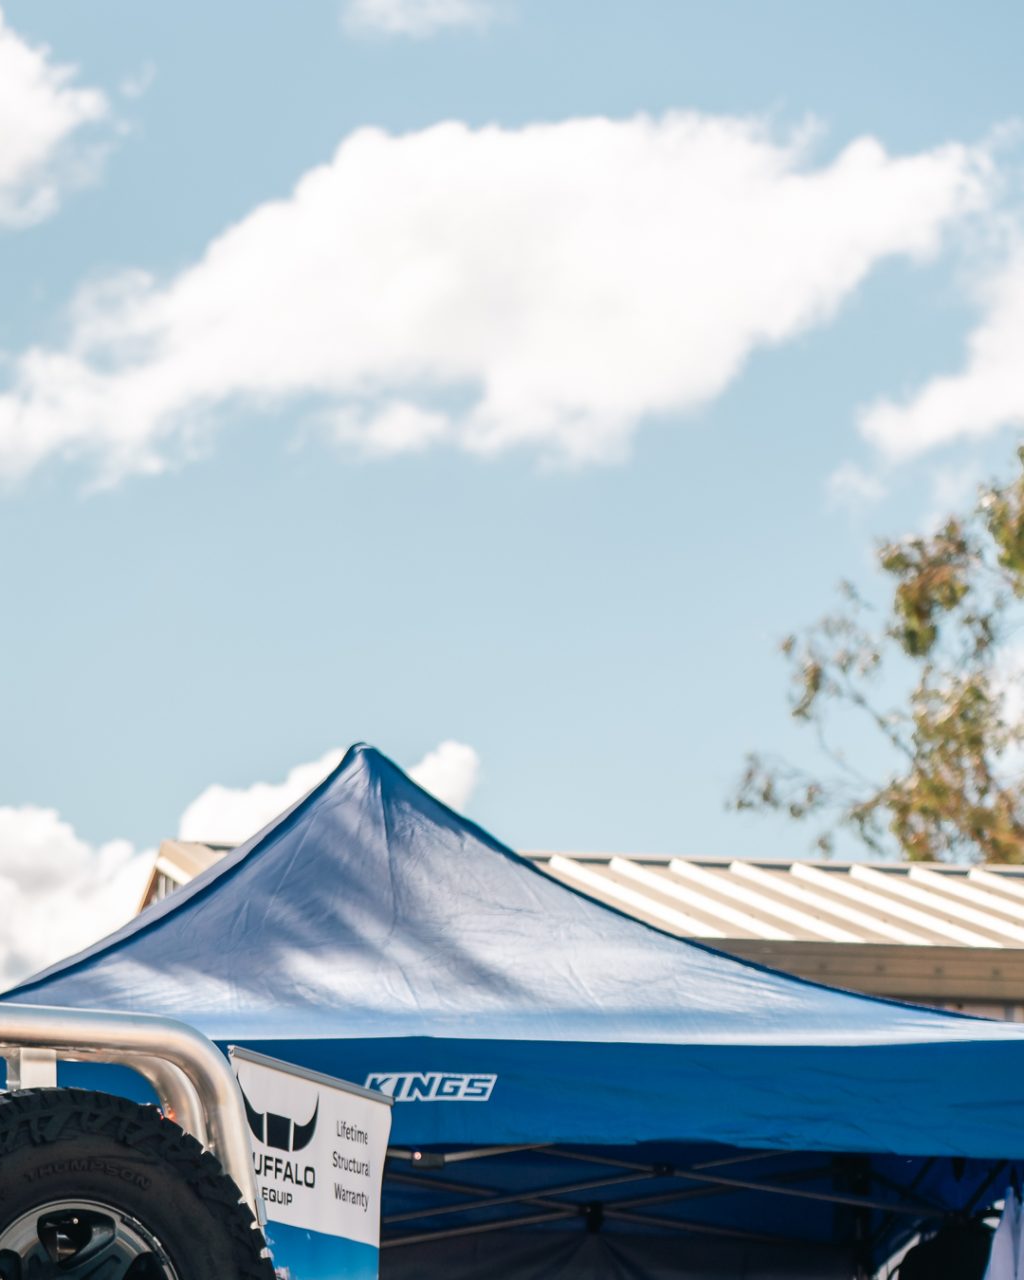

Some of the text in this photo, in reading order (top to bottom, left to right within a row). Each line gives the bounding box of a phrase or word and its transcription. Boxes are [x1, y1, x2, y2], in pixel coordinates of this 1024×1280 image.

[365, 1072, 497, 1101] KINGS
[336, 1120, 369, 1145] Lifetime
[23, 1158, 152, 1191] THOMPSON
[252, 1151, 316, 1189] UFFALO
[332, 1151, 371, 1177] Structural
[261, 1186, 293, 1206] EQUIP
[334, 1182, 369, 1212] Warranty
